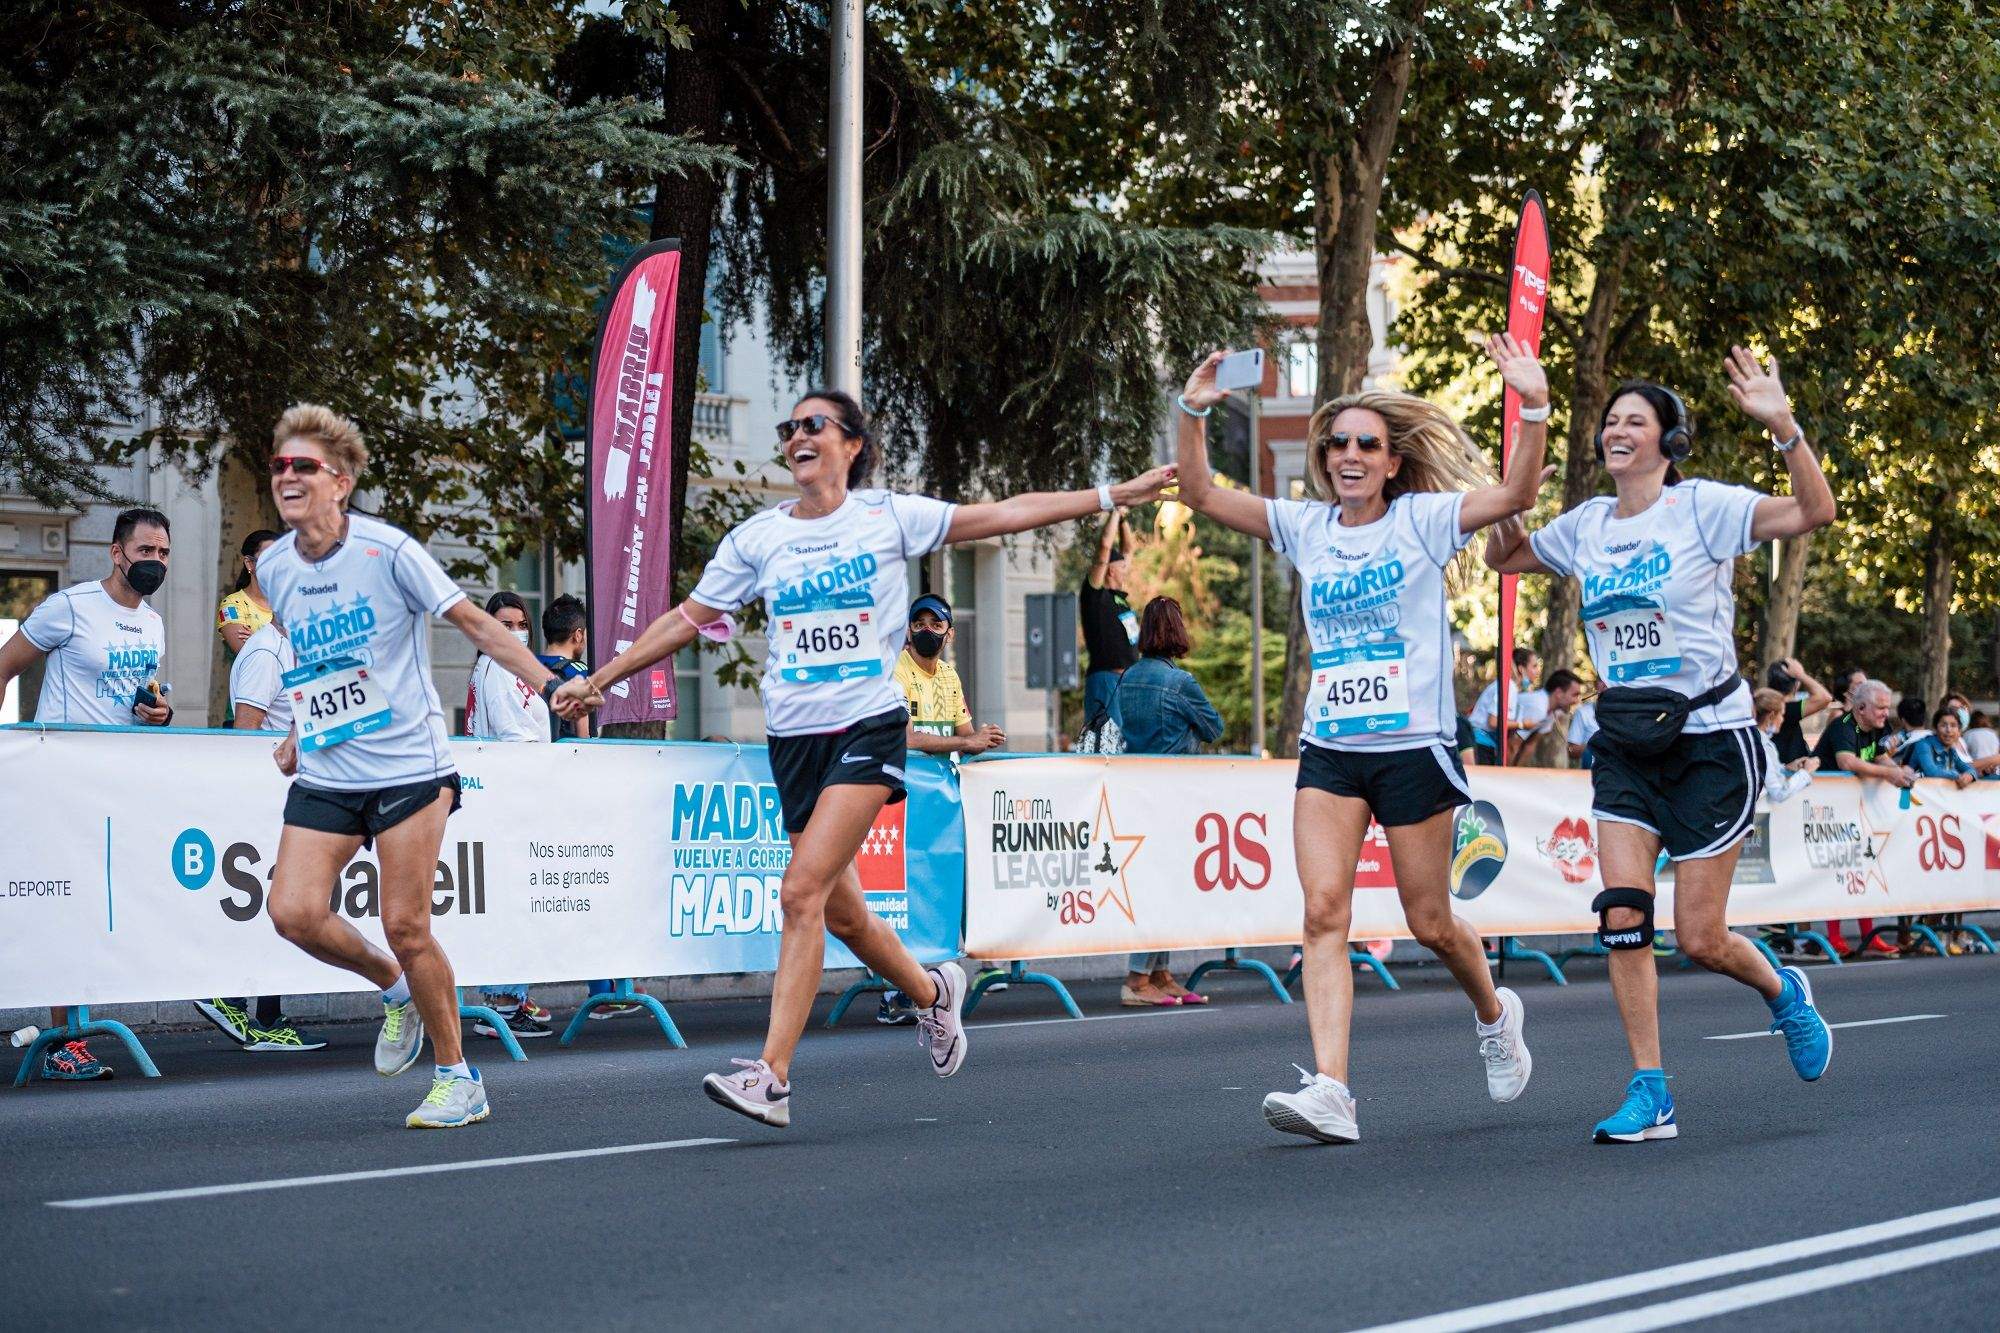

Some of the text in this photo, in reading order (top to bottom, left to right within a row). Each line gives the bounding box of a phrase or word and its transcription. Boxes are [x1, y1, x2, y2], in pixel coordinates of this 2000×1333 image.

[795, 542, 838, 554] Sabadell
[302, 582, 338, 596] Sabadell
[779, 553, 877, 601] MADRID
[1311, 560, 1404, 607] MADRID
[1585, 552, 1671, 601] MADRID
[1346, 603, 1353, 612] A
[1354, 589, 1397, 610] CORRER
[119, 623, 143, 634] Sabadell
[290, 605, 375, 651] MADRID
[1311, 602, 1400, 645] MADRID
[1615, 621, 1661, 651] 4296
[321, 649, 328, 658] A
[329, 635, 368, 653] CORRER
[796, 624, 860, 654] 4663
[610, 639, 634, 699] UA
[310, 681, 366, 719] 4375
[1327, 676, 1388, 706] 4526
[459, 776, 484, 789] PAL
[671, 784, 790, 841] MADR
[992, 821, 1090, 852] RUNNING
[1803, 822, 1861, 843] RUNNING
[1916, 814, 1966, 871] as
[529, 841, 614, 858] Nos sumamos
[674, 848, 792, 868] VUELVE A CORRE
[1194, 812, 1271, 892] as
[1805, 844, 1862, 869] LEAGUE
[219, 841, 486, 922] Saell
[529, 868, 610, 889] a las grandes
[992, 852, 1091, 890] LEAGUE
[1847, 871, 1865, 895] as
[9, 880, 72, 897] DEPORTE
[531, 895, 591, 913] iniciativas
[671, 874, 784, 937] MADR
[1047, 890, 1095, 925] by as
[881, 914, 908, 929] drid
